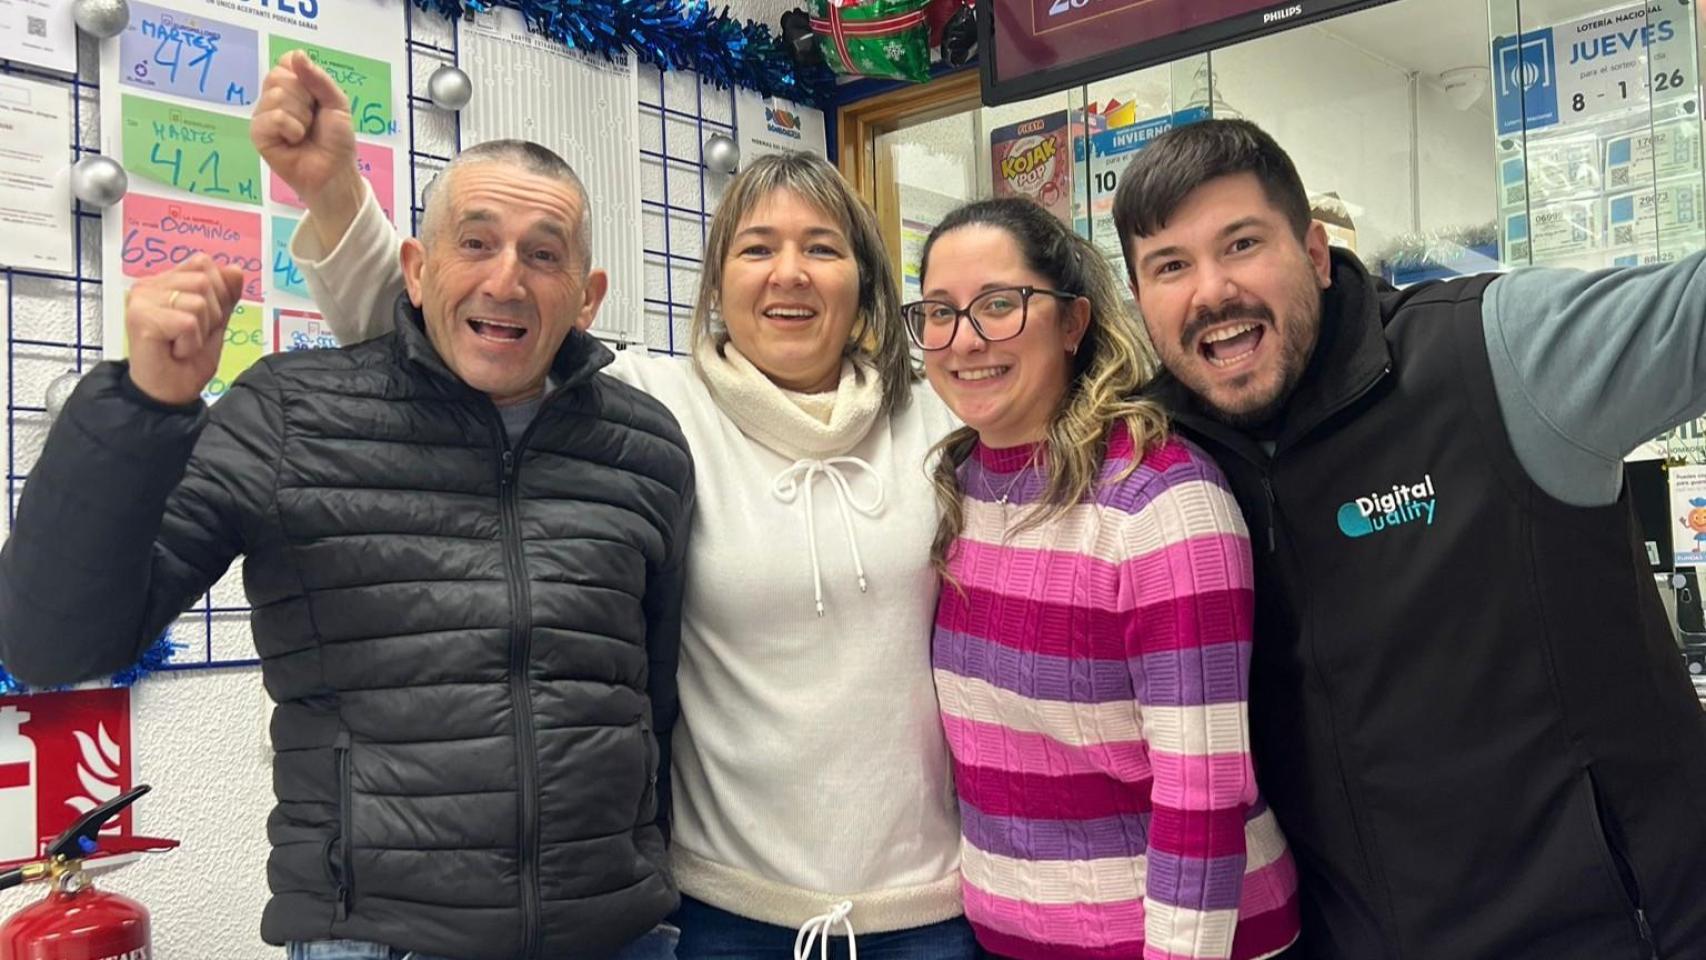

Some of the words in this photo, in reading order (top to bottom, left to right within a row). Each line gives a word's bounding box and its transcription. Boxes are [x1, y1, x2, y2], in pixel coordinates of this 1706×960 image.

[1263, 4, 1302, 24] PHILIPS
[1576, 18, 1612, 33] LOTERÍA
[141, 20, 218, 52] MARTES
[1570, 20, 1674, 65] JUEVES
[1580, 70, 1597, 79] para
[1611, 60, 1636, 71] sorteo
[1572, 93, 1585, 112] 8
[1618, 80, 1627, 99] 1
[1654, 68, 1684, 92] 26
[1112, 124, 1172, 148] INVIERNO
[150, 142, 230, 193] 4,1
[1001, 135, 1057, 180] KOJAK
[1017, 164, 1046, 187] POP
[1094, 170, 1117, 193] 10
[160, 216, 241, 241] DOMINGO
[1355, 473, 1435, 517] Digital
